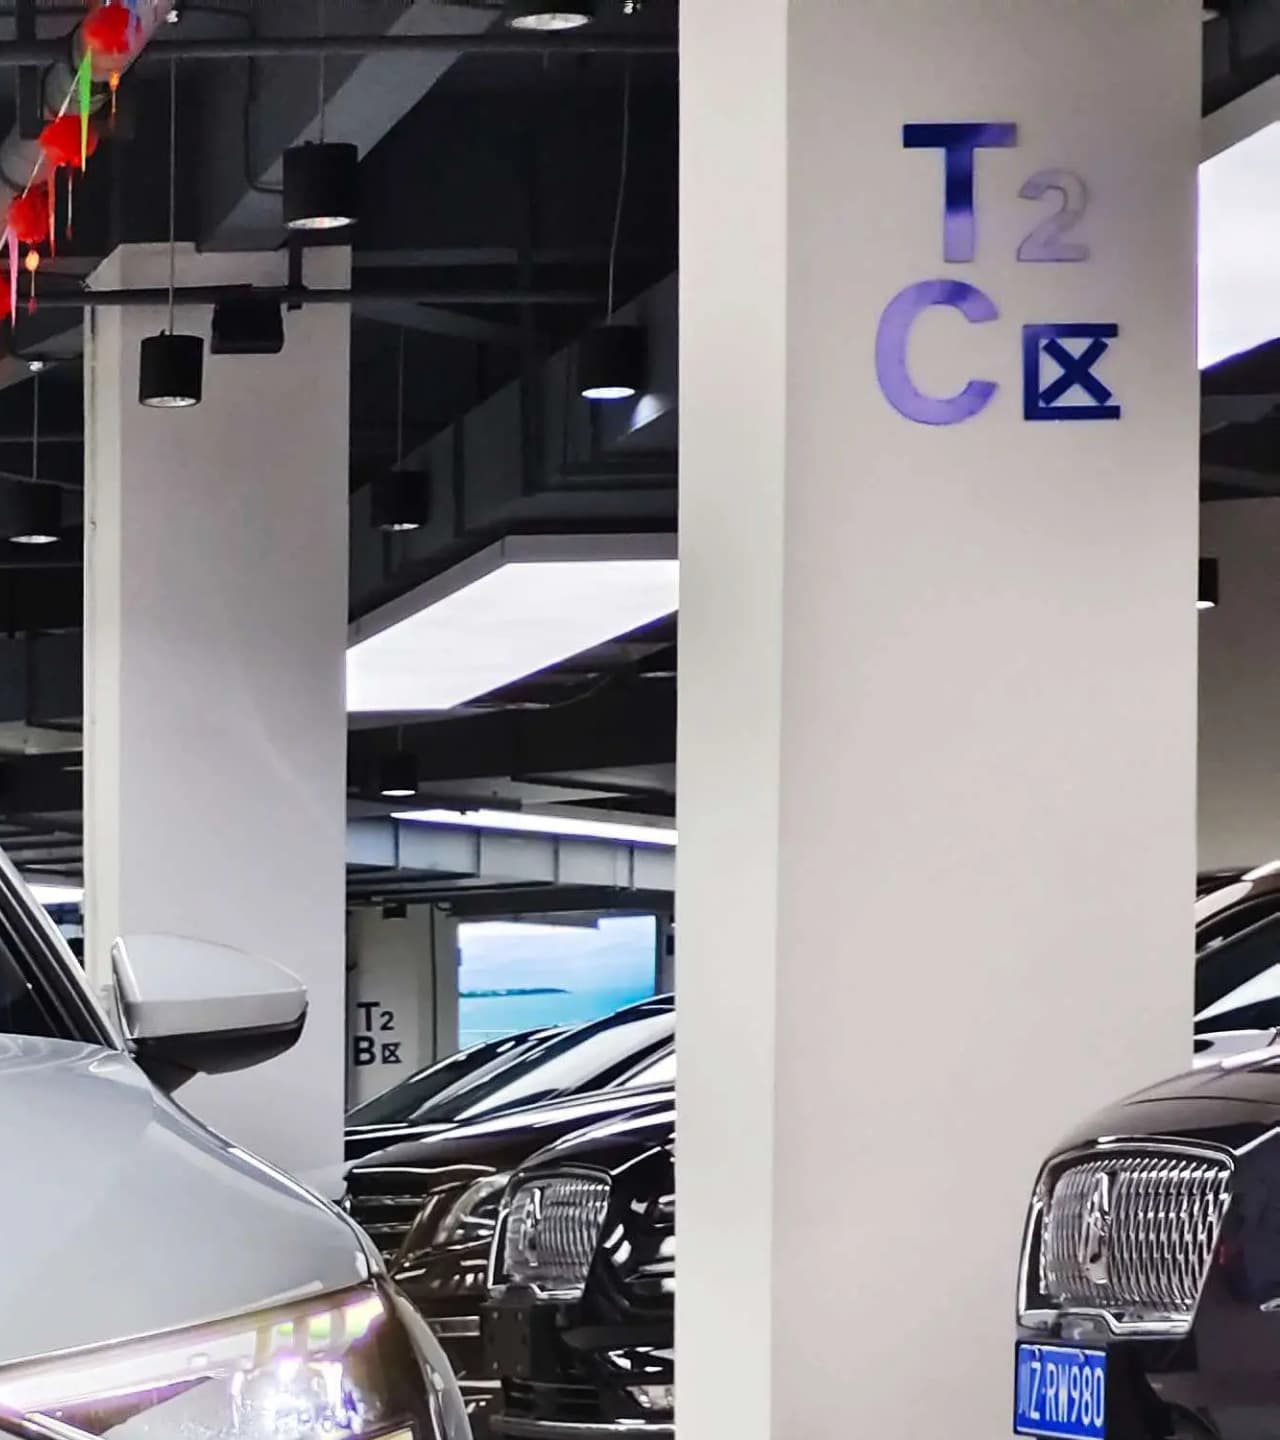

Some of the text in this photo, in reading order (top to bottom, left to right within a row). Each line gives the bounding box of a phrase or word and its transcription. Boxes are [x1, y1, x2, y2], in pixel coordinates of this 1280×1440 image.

[902, 122, 1091, 263] T2
[874, 278, 1122, 426] C区
[353, 1035, 403, 1067] B区
[356, 1001, 395, 1032] T2
